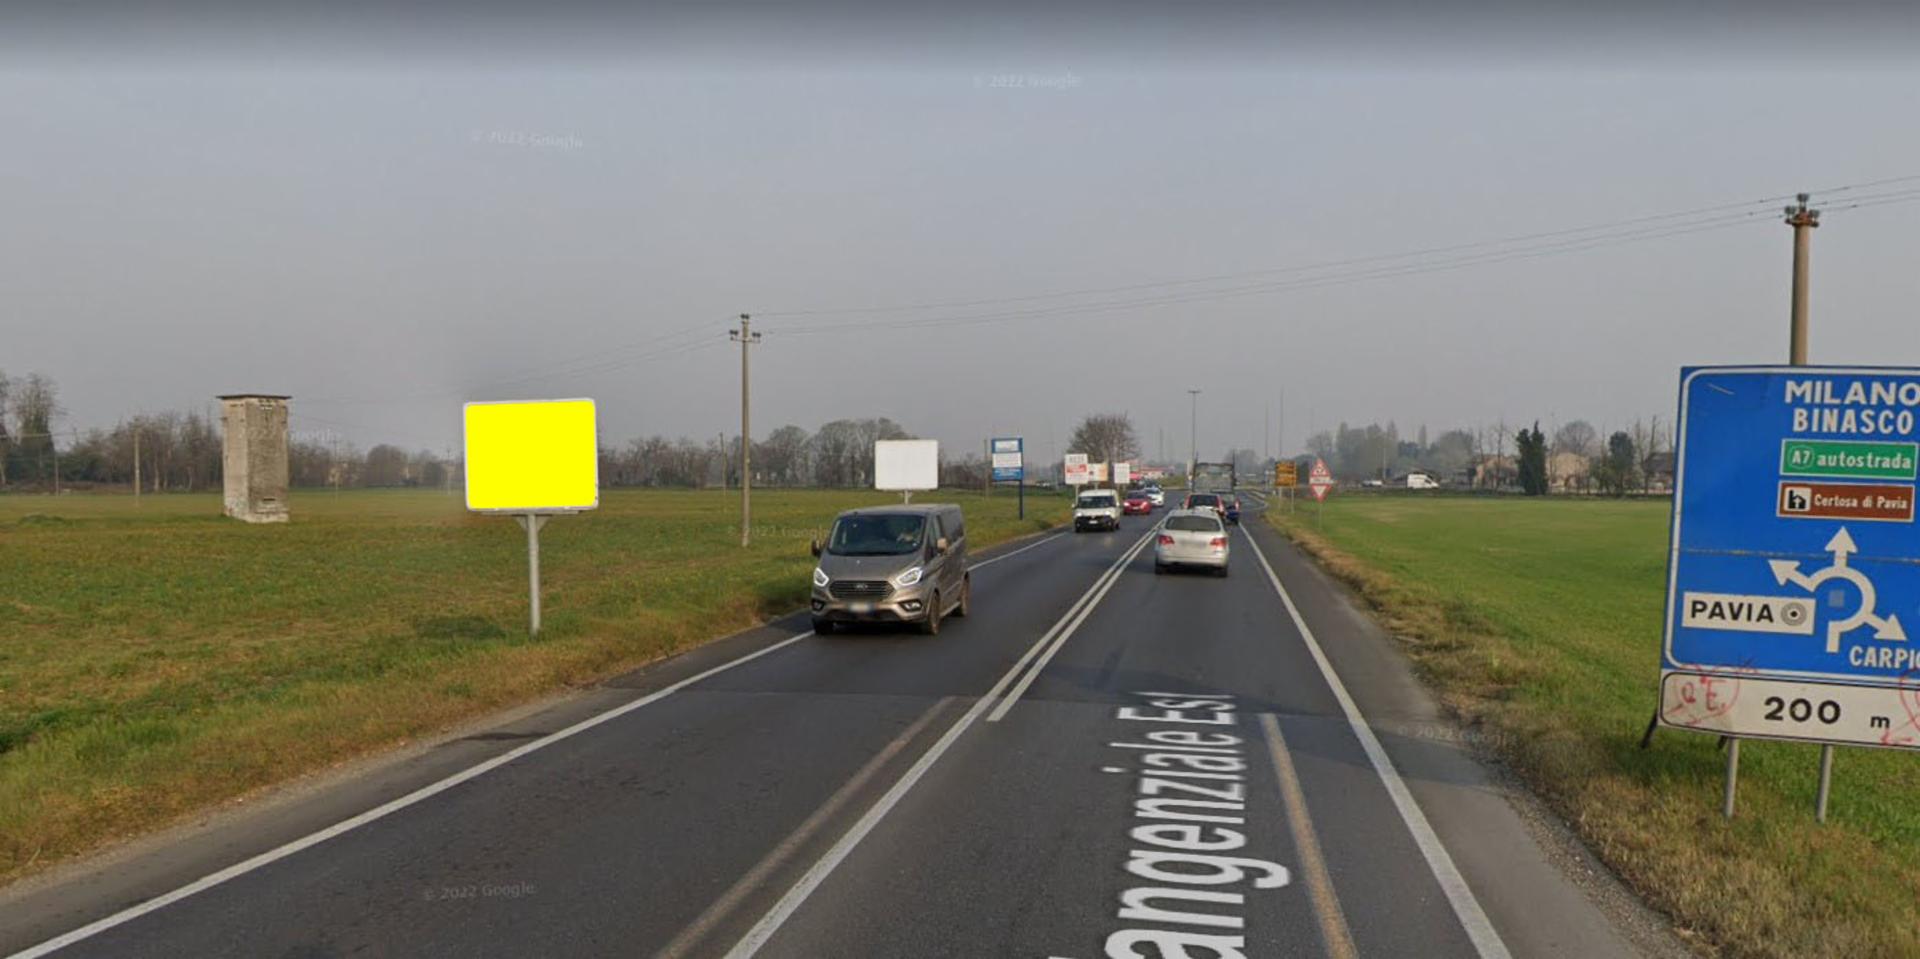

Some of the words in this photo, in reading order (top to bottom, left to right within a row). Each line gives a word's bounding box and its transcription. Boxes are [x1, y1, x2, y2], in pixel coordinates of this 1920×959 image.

[1785, 380, 1920, 405] MILANO
[1793, 408, 1914, 435] BINASCO
[1791, 450, 1811, 465] A7
[1816, 453, 1913, 470] autostrada
[1814, 493, 1858, 509] Certosa
[1862, 495, 1874, 508] di
[1876, 496, 1908, 510] Pavia
[1690, 599, 1774, 623] PAVIA
[1764, 696, 1841, 725] 200
[1870, 714, 1890, 730] m
